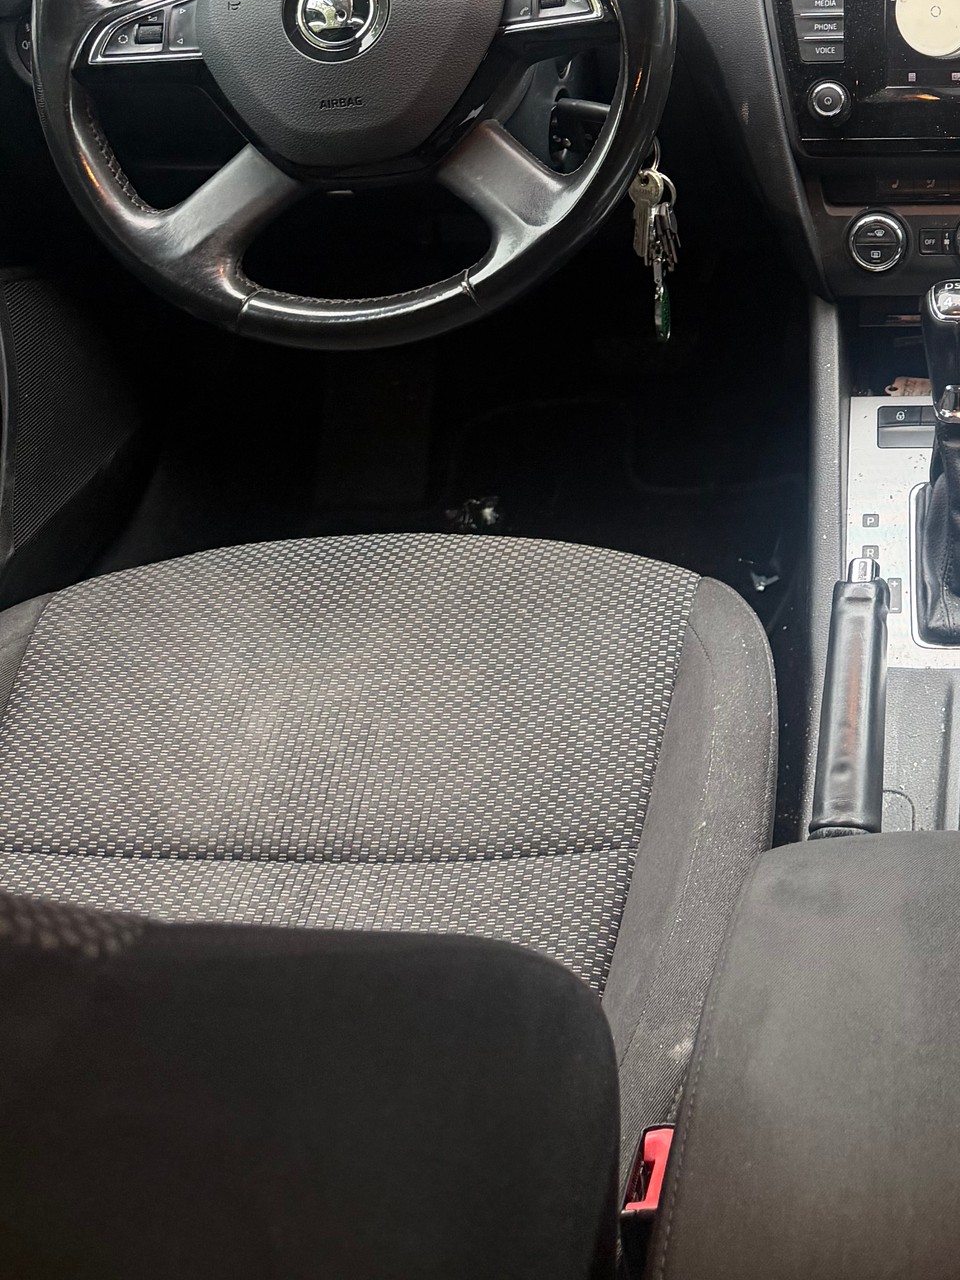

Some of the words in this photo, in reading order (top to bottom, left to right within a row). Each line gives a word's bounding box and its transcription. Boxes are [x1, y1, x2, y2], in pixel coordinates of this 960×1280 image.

[319, 96, 363, 110] AIRBAG
[866, 516, 875, 526] P
[866, 548, 875, 558] R
